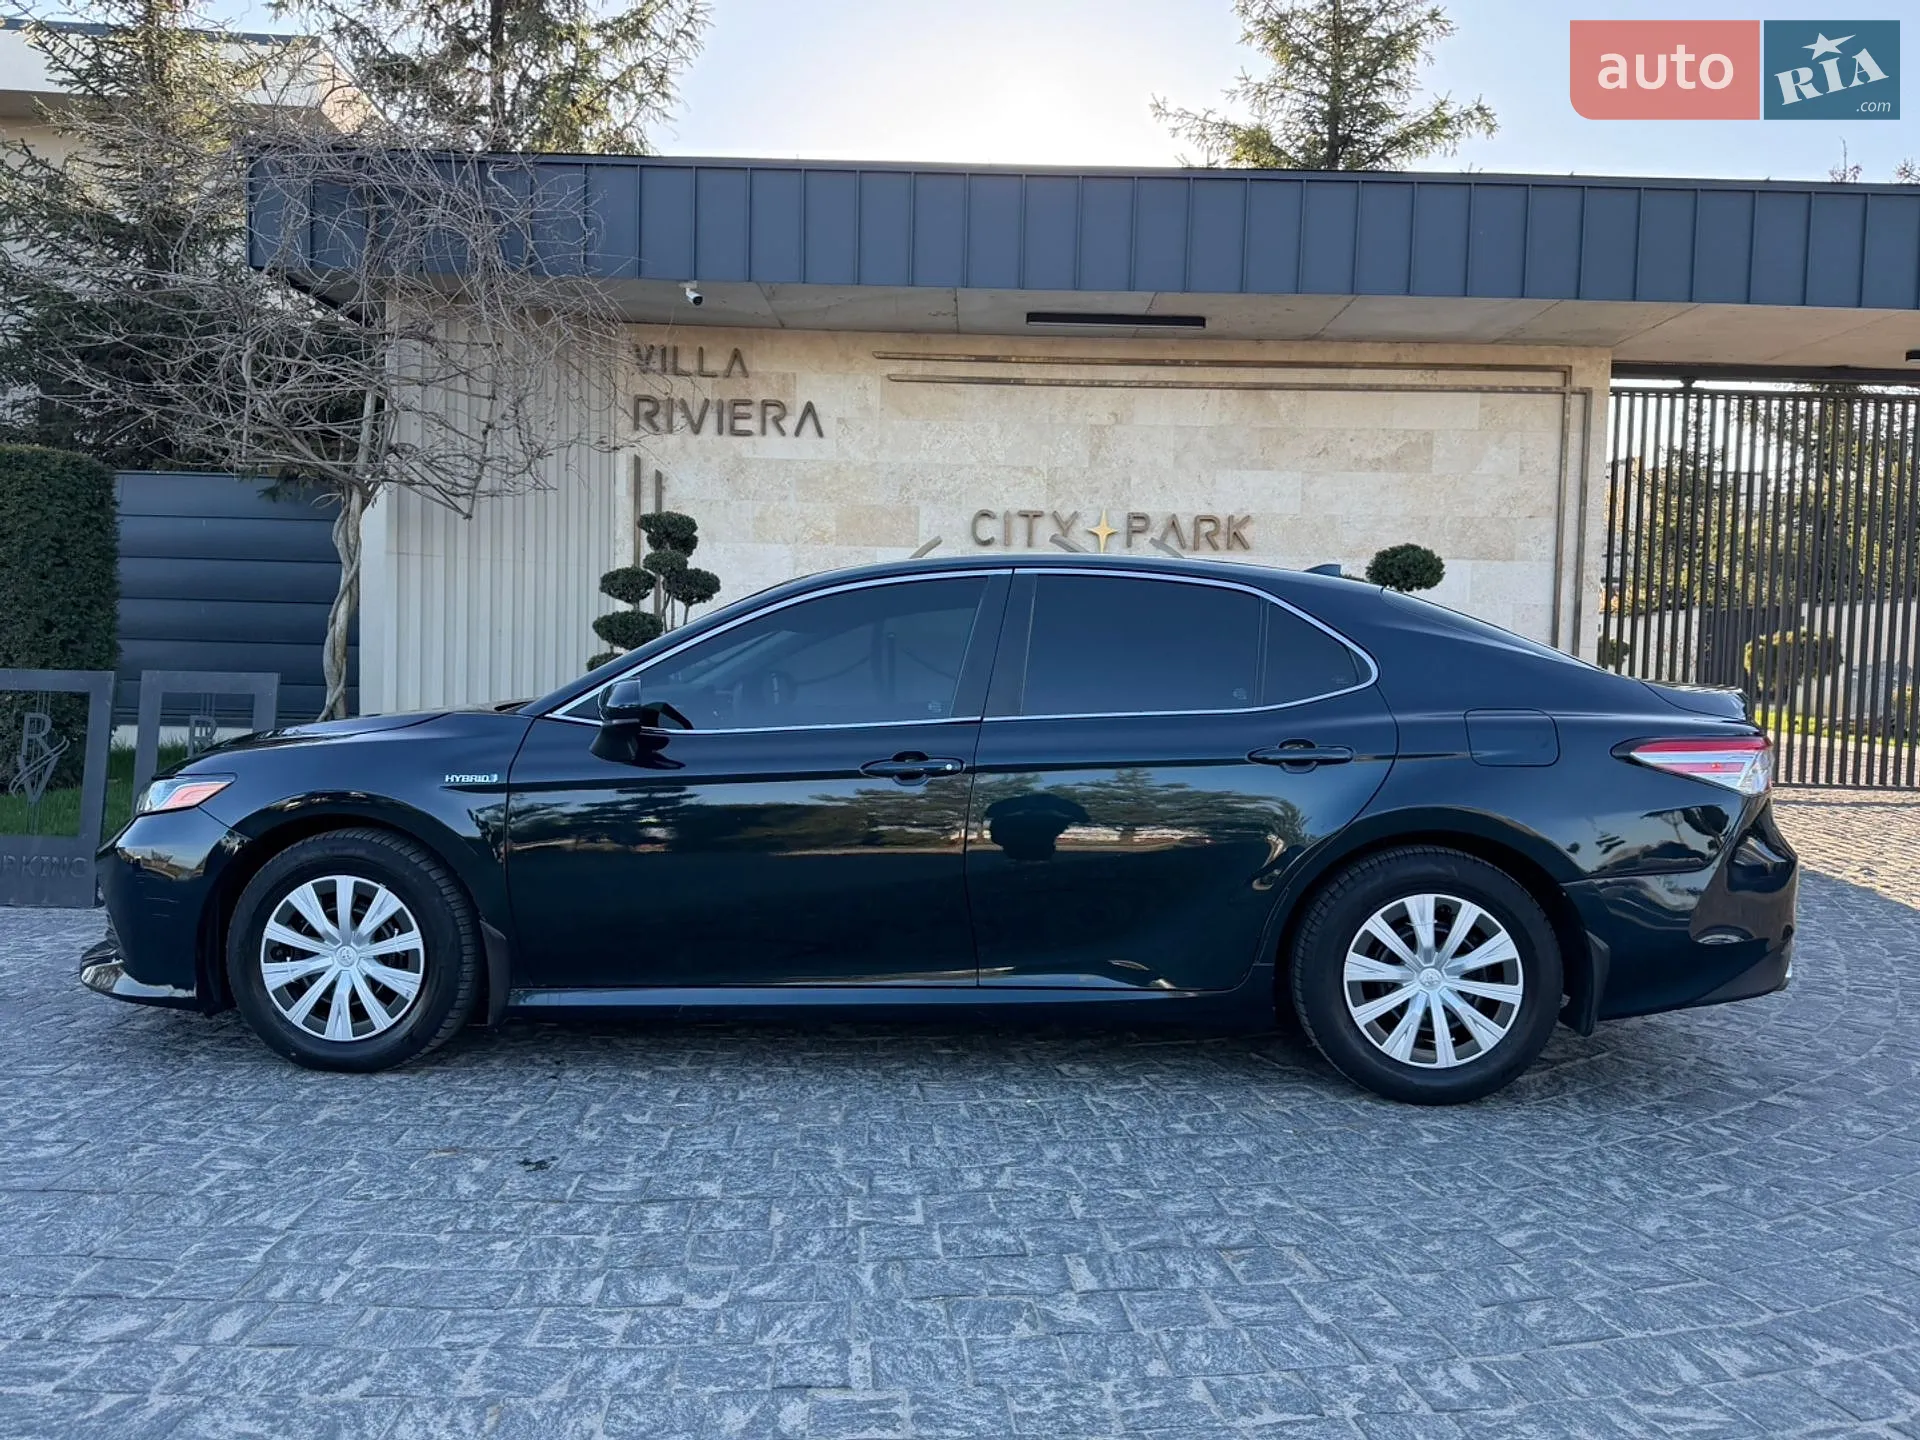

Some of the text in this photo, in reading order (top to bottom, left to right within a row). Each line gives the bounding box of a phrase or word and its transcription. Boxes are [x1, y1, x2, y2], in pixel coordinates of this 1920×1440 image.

[634, 344, 750, 378] VILLA
[633, 394, 824, 438] RIVIERA
[971, 509, 1252, 551] CITY PARK
[445, 774, 489, 783] HYBRID
